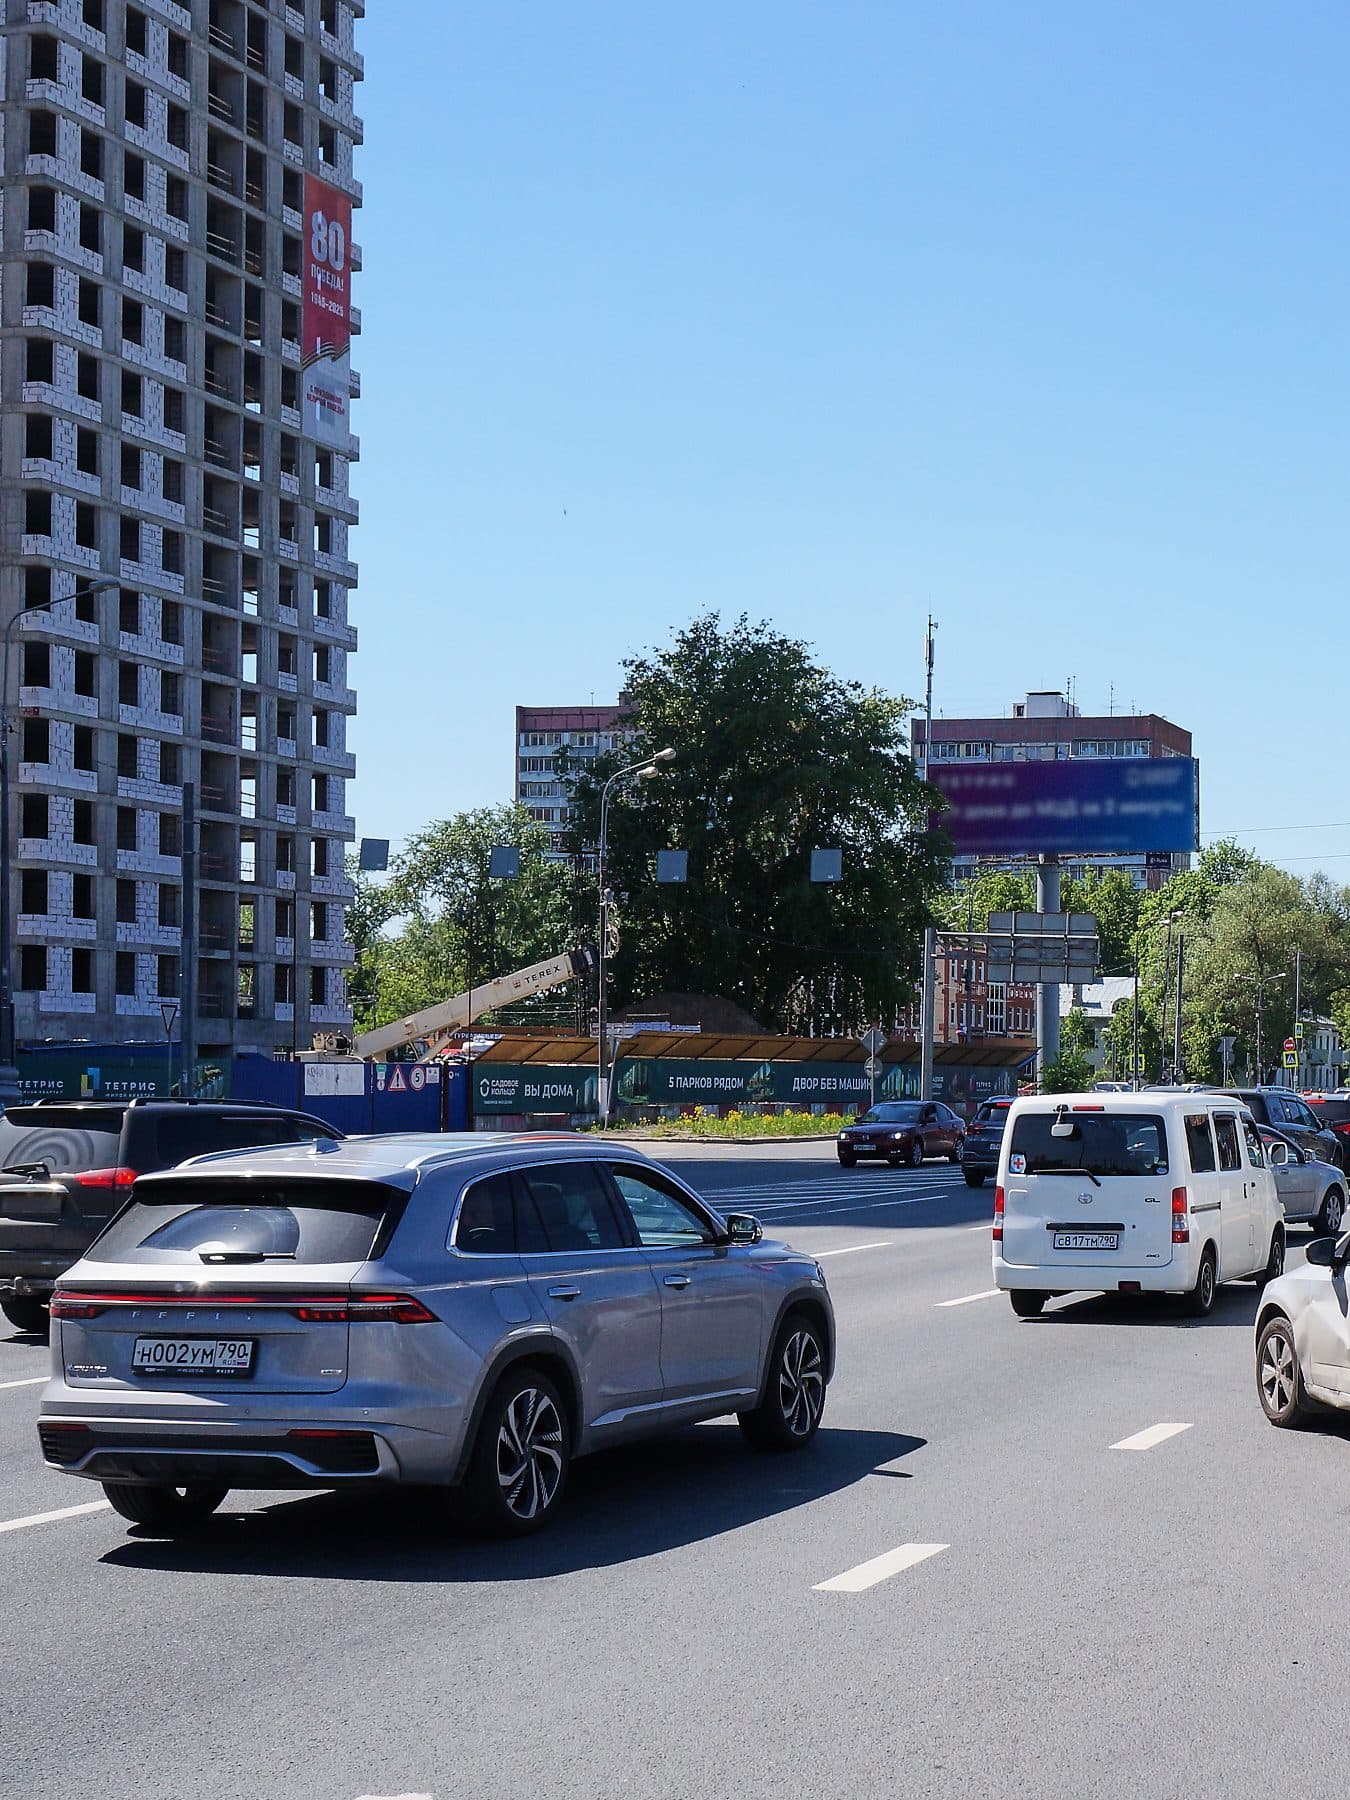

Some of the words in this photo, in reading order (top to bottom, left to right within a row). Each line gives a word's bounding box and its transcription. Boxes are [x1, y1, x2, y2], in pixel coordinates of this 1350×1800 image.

[312, 210, 345, 271] 80
[524, 964, 561, 984] TEREX
[415, 1071, 421, 1083] 5
[491, 1079, 520, 1087] САДОВОЕ
[668, 1076, 674, 1088] 5
[676, 1076, 712, 1089] ПАРКОВ
[713, 1077, 744, 1090] РЯДОМ
[17, 1080, 64, 1088] ТЕТРИС
[104, 1081, 156, 1091] ТЕТРИС
[792, 1077, 819, 1092] ДВОР
[820, 1077, 838, 1090] БЕЗ
[839, 1077, 873, 1091] МАШИН
[491, 1088, 516, 1096] КОЛЬЦО
[524, 1084, 540, 1097] ВЫ
[542, 1084, 574, 1099] ДОМА
[1058, 1235, 1098, 1247] С817ТМ
[1099, 1235, 1115, 1244] 790
[140, 1342, 215, 1364] Н002УМ
[218, 1342, 246, 1359] 790
